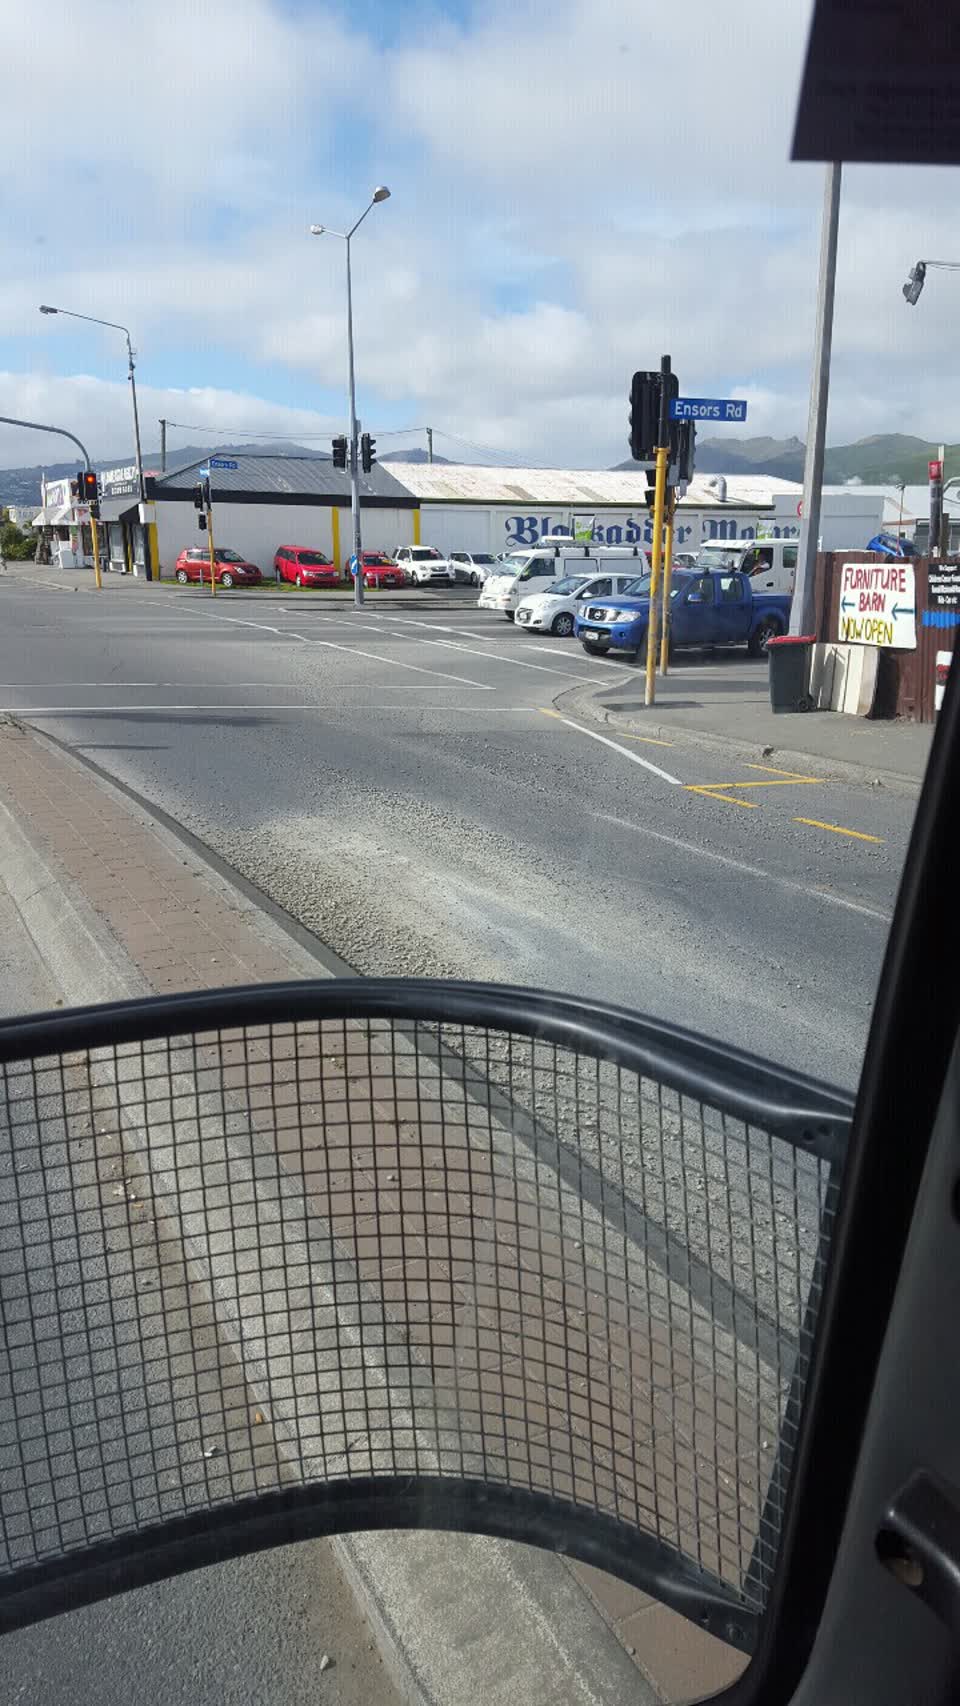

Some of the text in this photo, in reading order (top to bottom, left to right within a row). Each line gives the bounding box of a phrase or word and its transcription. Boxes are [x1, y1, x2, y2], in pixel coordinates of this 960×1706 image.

[675, 401, 743, 418] Ensors Rd
[505, 517, 800, 546] Blakaddr Mor
[844, 567, 906, 592] FURNITURE
[859, 592, 886, 612] BARN
[841, 616, 893, 645] NOW OPEN
